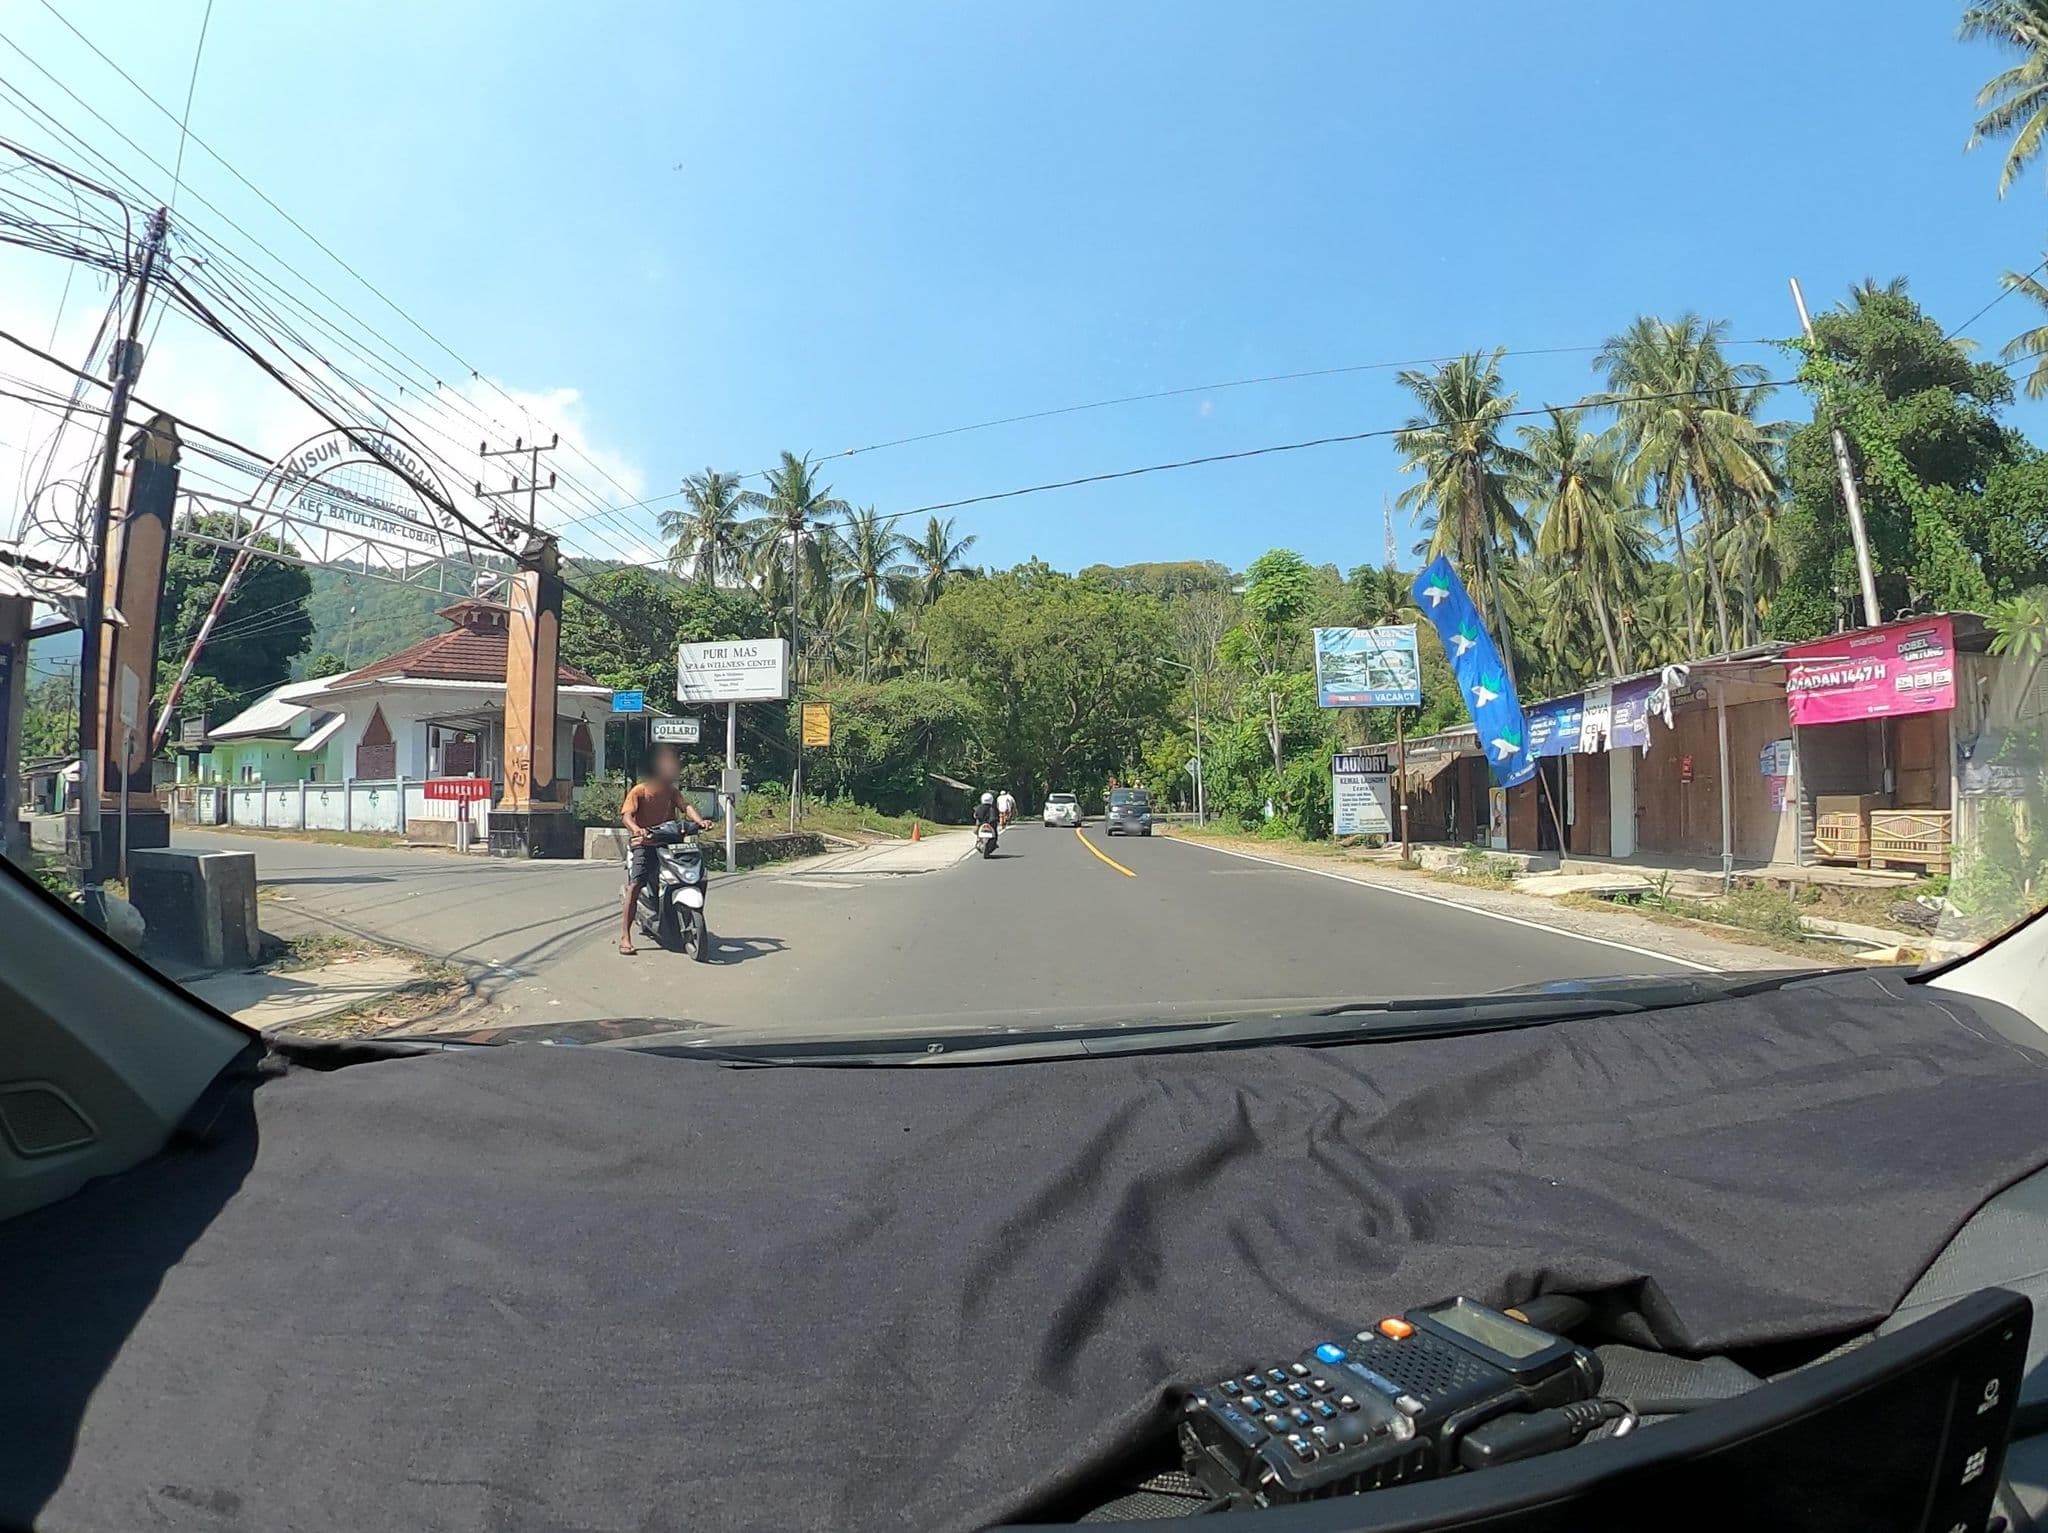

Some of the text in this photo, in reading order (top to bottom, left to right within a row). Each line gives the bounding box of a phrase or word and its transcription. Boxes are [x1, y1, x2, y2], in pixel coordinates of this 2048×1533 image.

[1898, 638, 1928, 653] DOBEL
[703, 646, 758, 660] PURI MAS
[746, 658, 777, 667] CENTER
[1840, 666, 1872, 684] 1447
[1873, 663, 1887, 679] H
[1374, 692, 1415, 702] VACANCY
[653, 726, 697, 736] COLLARD
[1335, 756, 1387, 773] LAUNDRY
